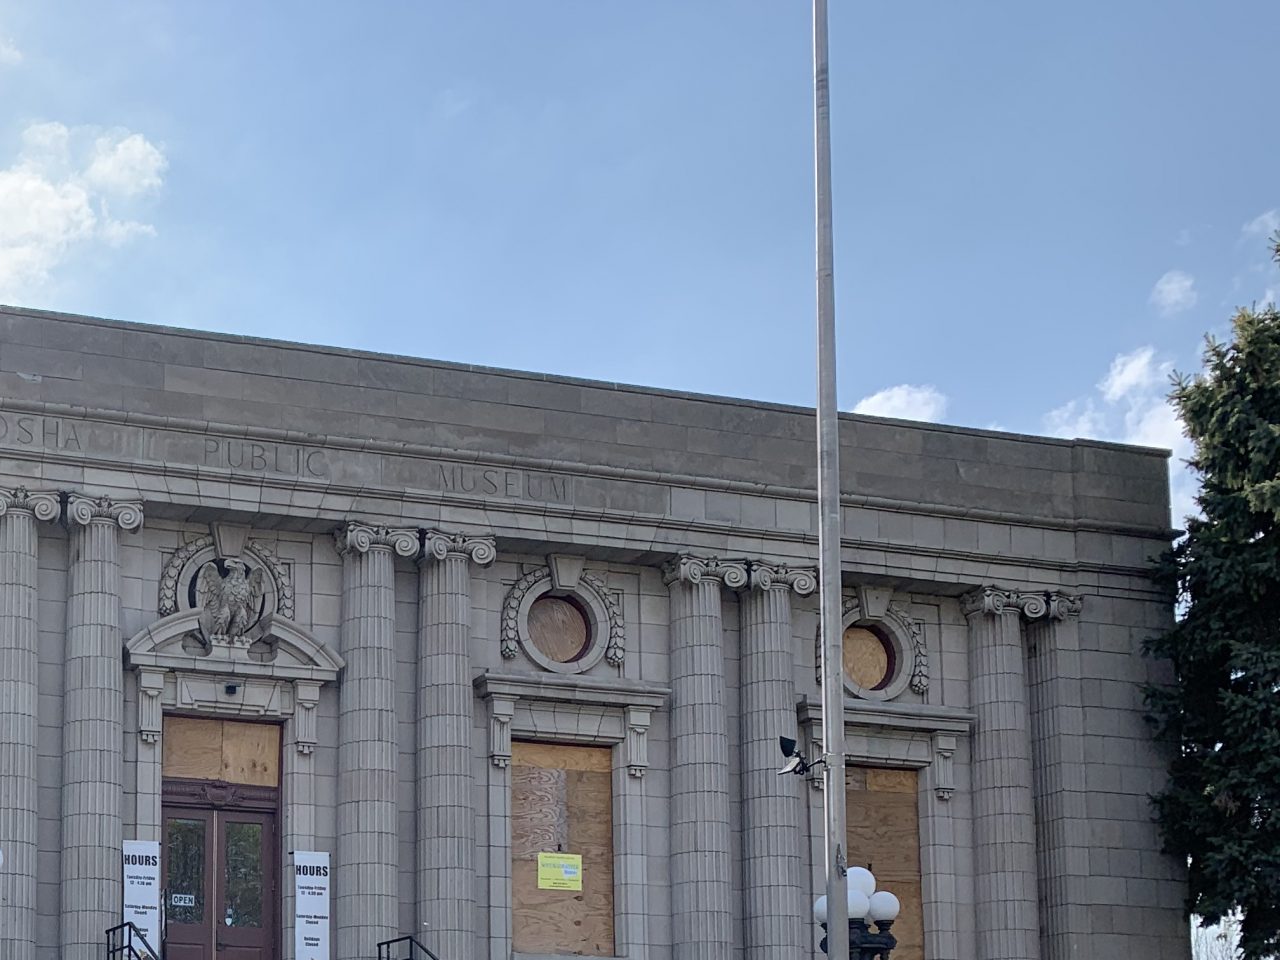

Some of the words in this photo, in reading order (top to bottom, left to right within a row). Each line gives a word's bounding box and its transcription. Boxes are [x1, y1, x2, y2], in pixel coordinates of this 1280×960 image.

[204, 437, 325, 477] PUBLIC
[438, 463, 567, 501] MUSEUM
[124, 854, 158, 866] HOURS
[296, 864, 328, 877] HOURS
[173, 895, 194, 905] OPEN
